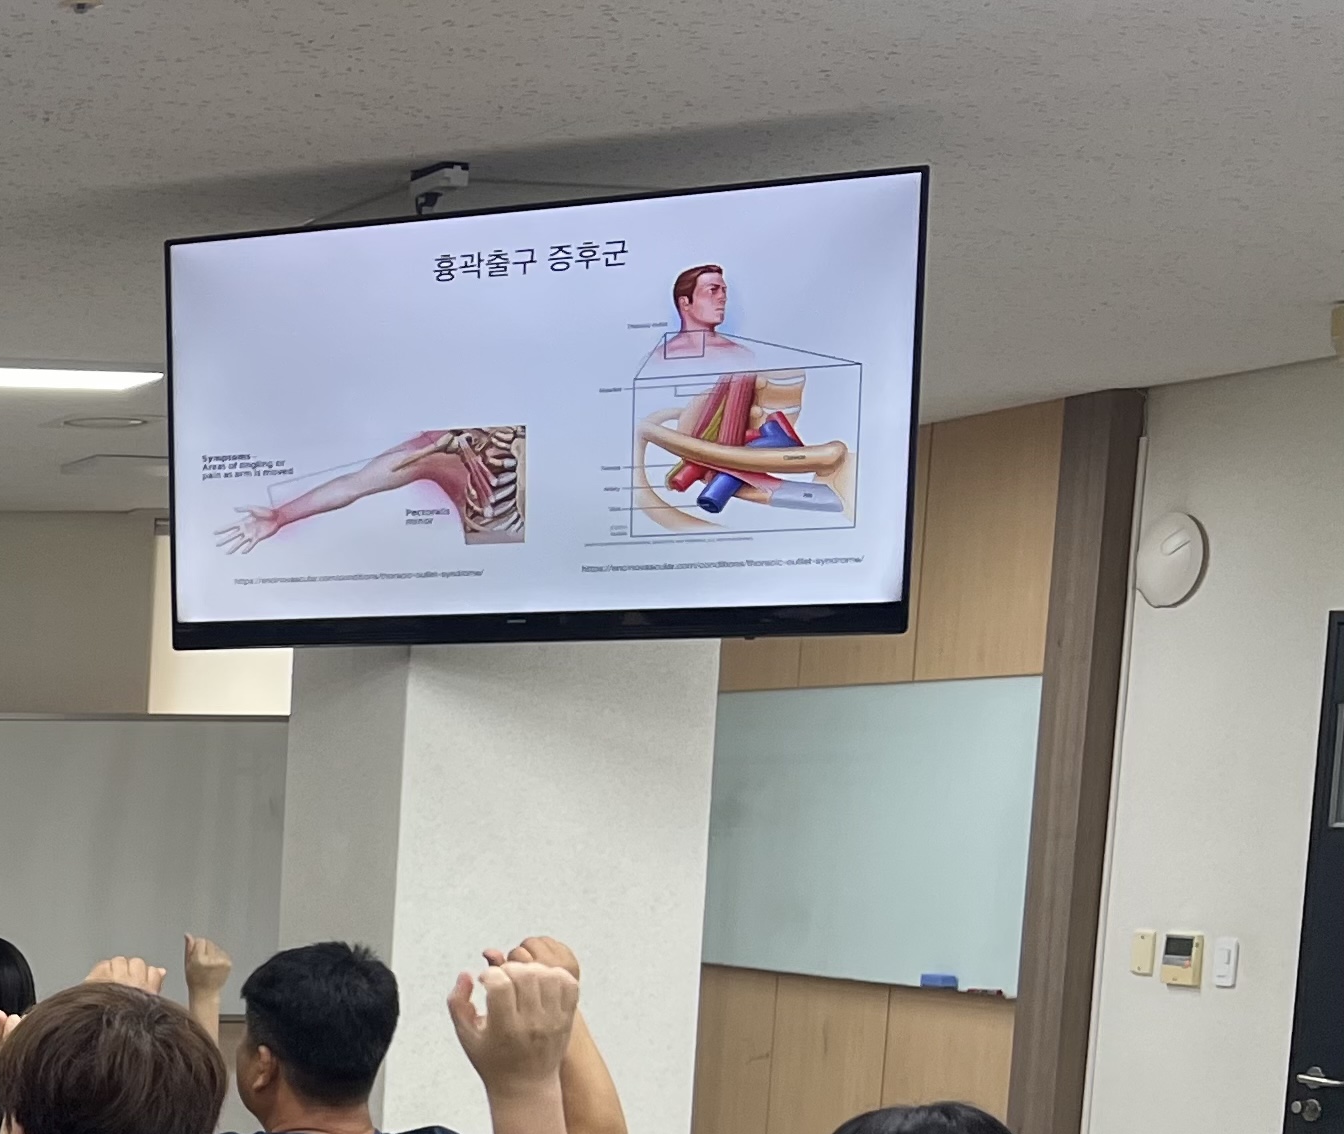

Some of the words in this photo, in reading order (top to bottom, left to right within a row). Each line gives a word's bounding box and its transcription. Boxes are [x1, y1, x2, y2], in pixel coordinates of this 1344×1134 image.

[432, 248, 538, 283] 흉곽출구
[547, 239, 629, 272] 증후군
[201, 453, 251, 463] Symptoms
